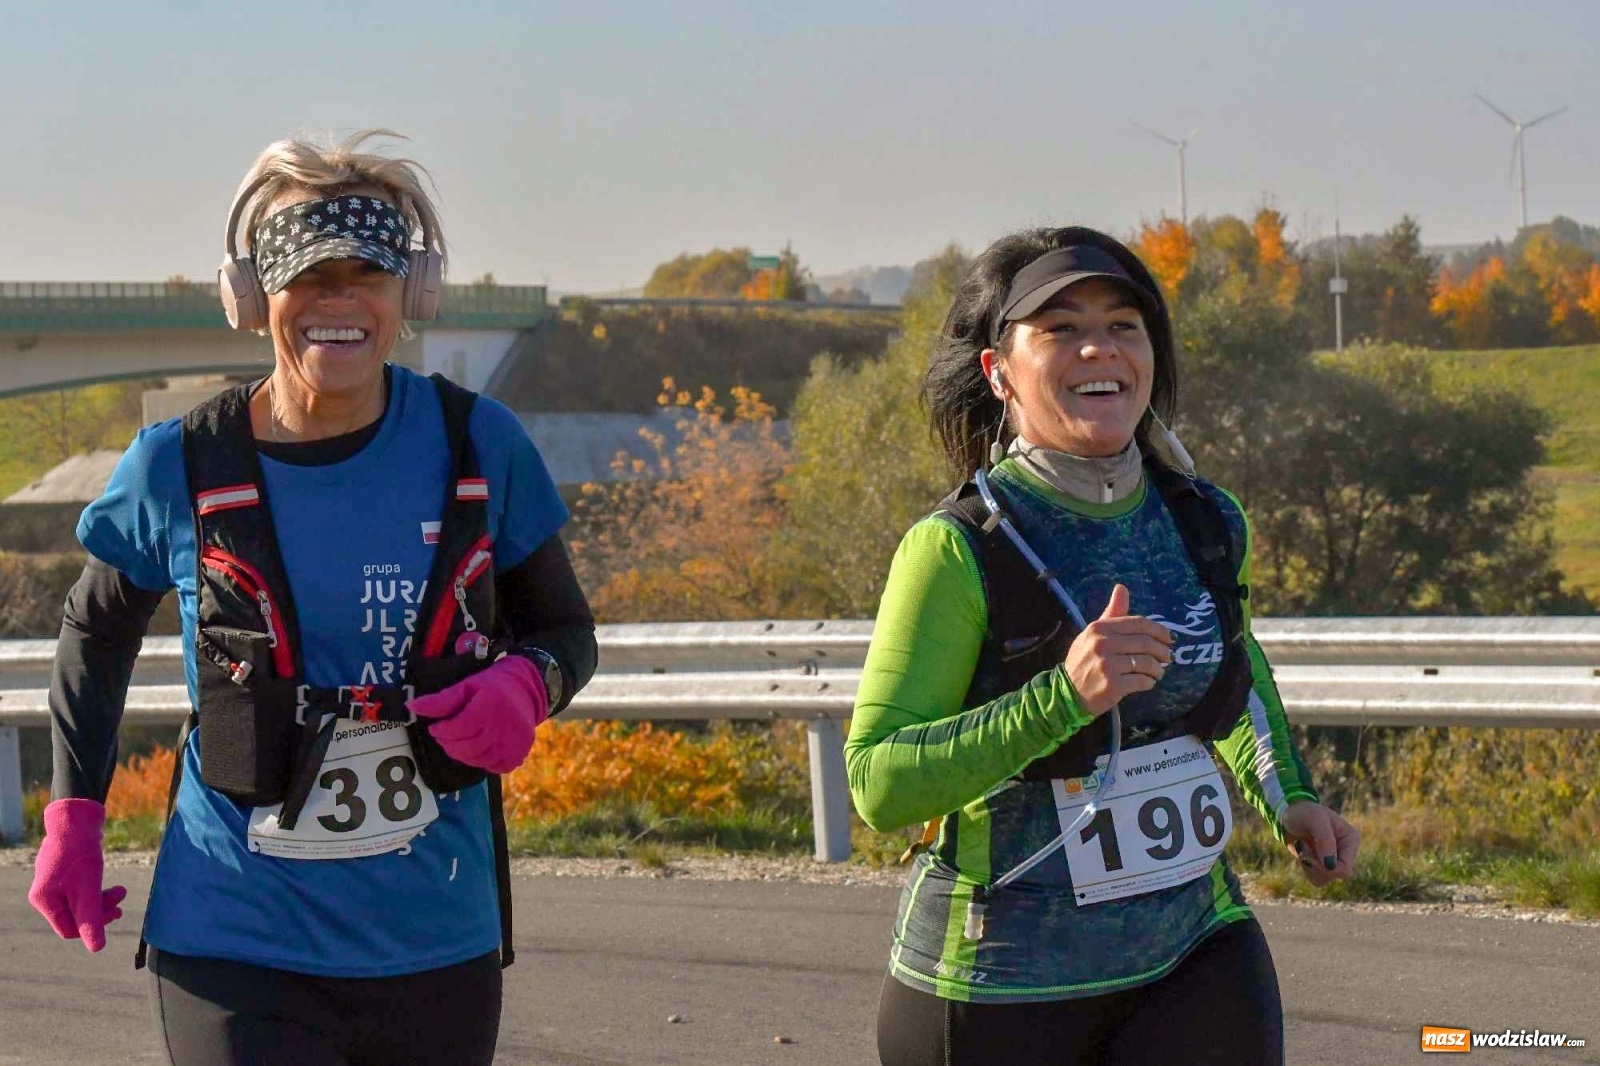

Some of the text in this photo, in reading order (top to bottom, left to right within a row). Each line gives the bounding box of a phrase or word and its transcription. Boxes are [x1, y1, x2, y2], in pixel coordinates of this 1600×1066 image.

[363, 564, 401, 577] grupa
[1160, 642, 1224, 667] CZE
[316, 755, 423, 833] 38
[1079, 784, 1226, 873] 196
